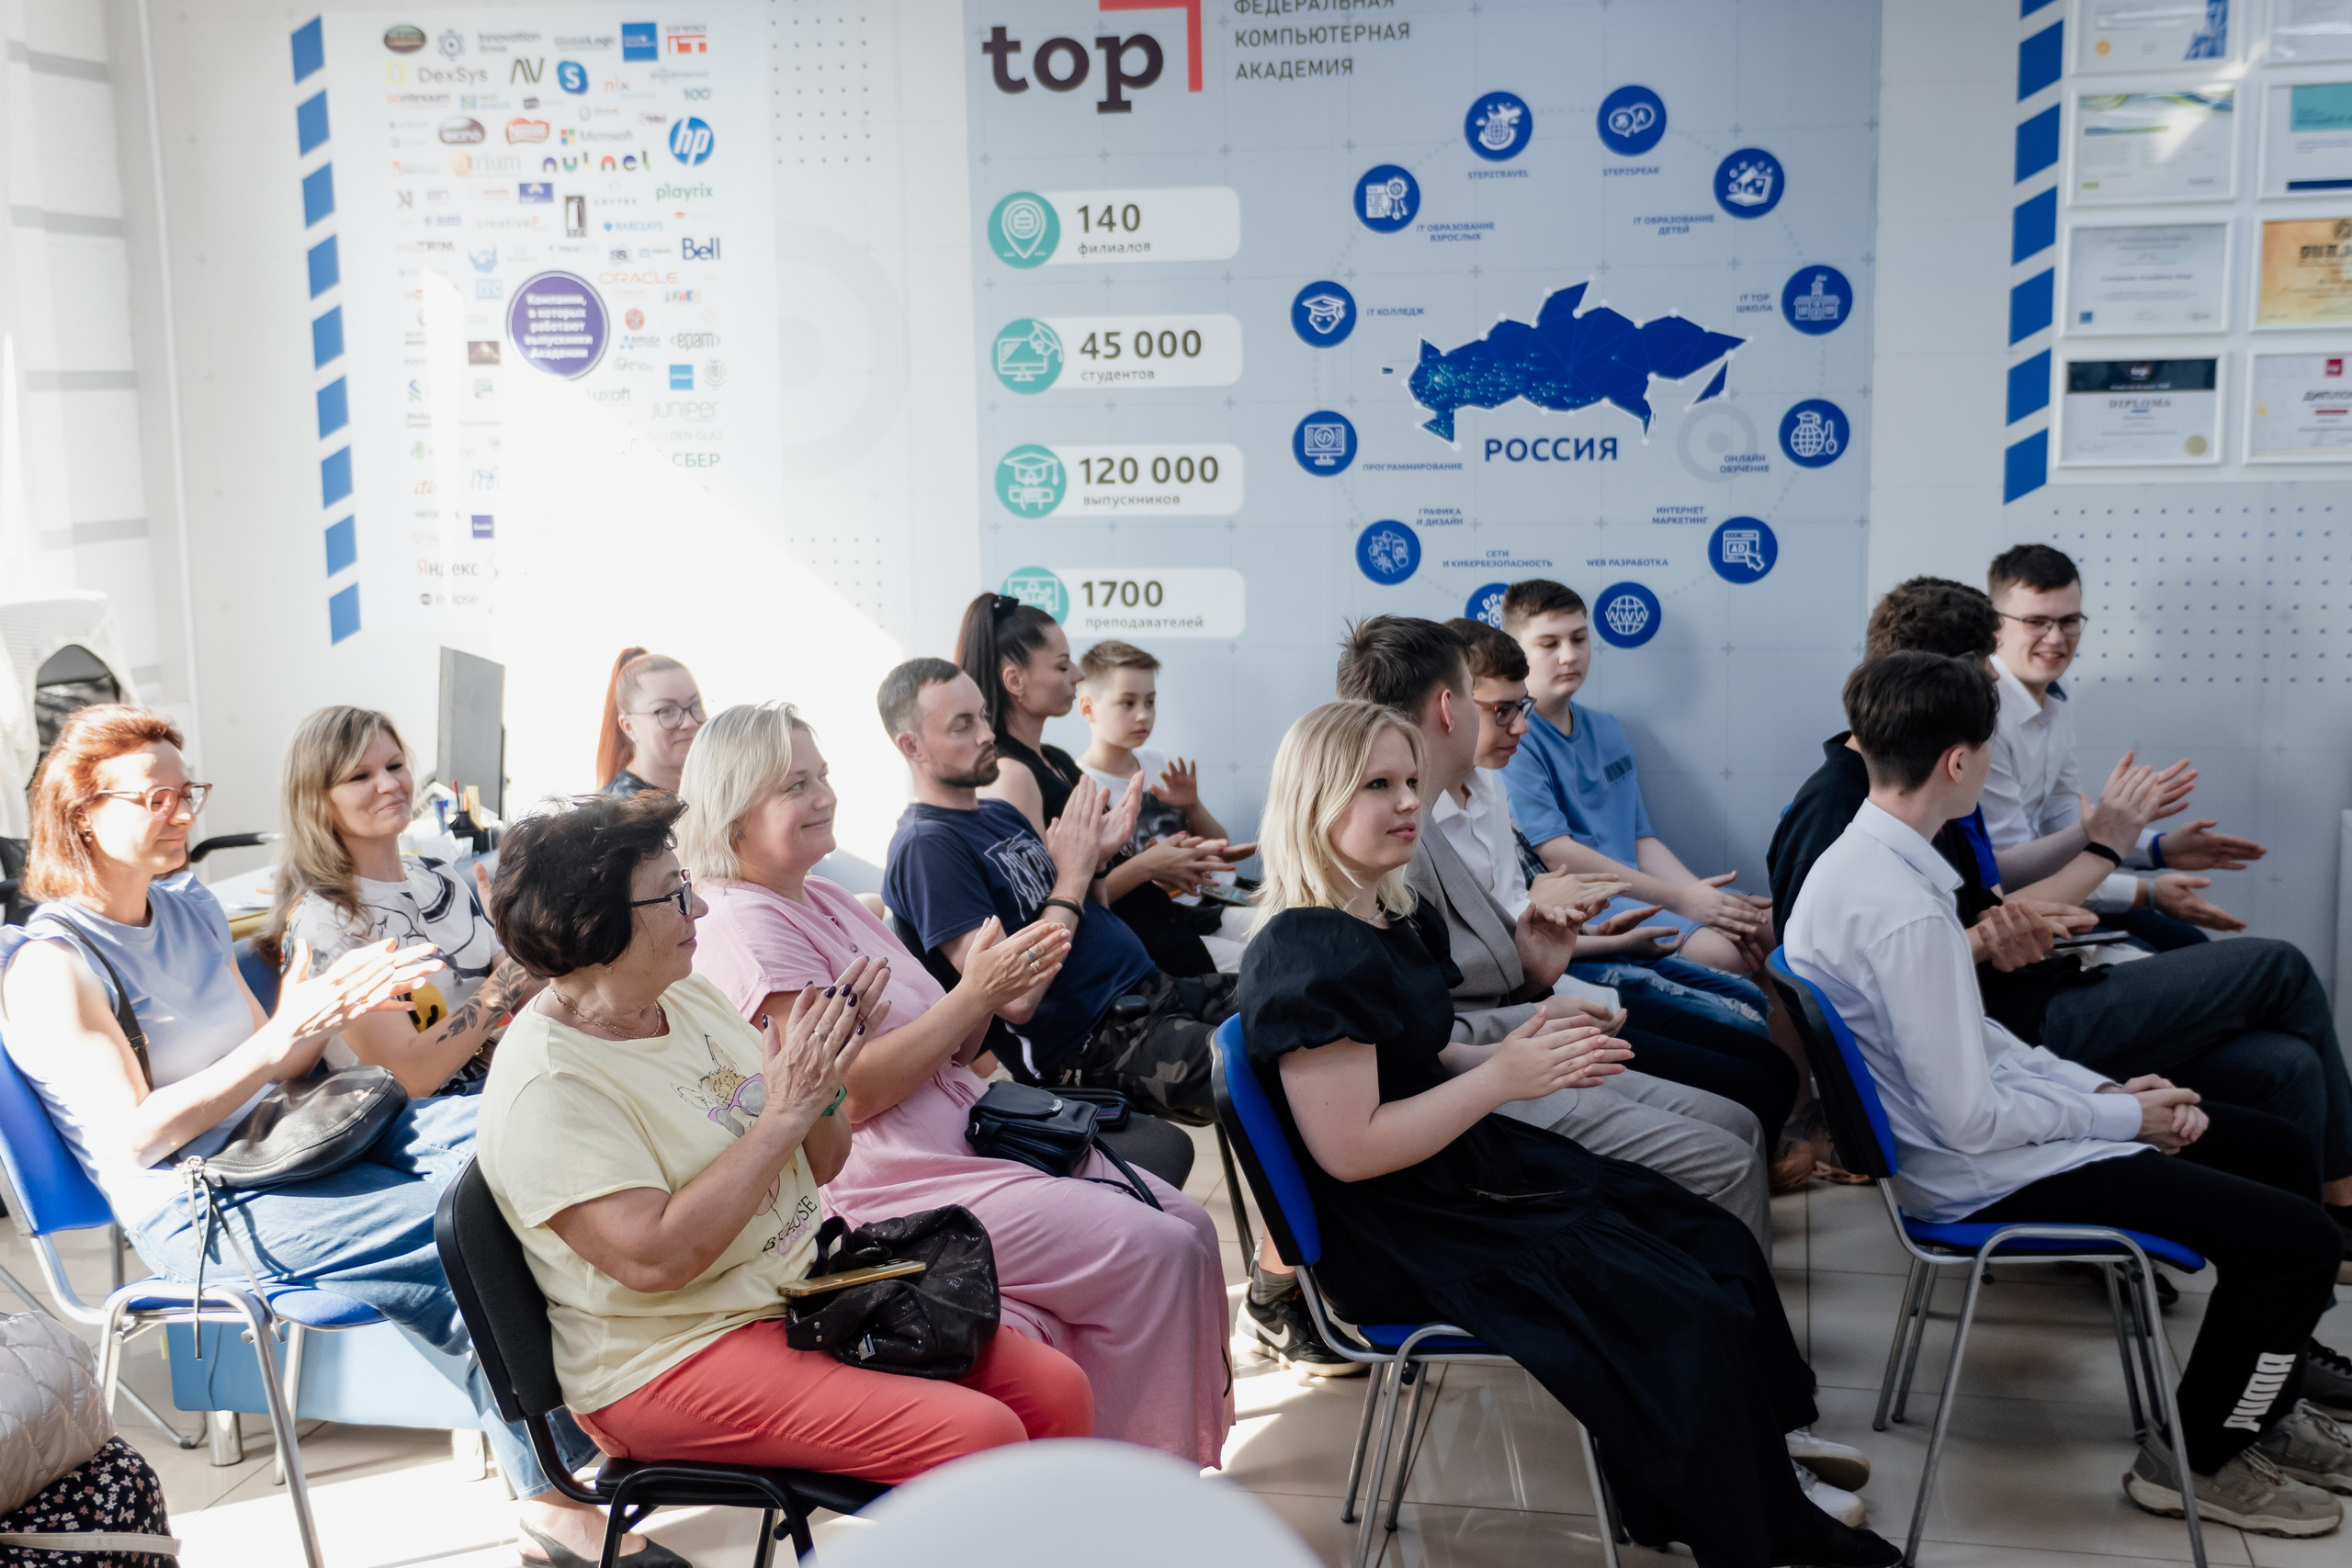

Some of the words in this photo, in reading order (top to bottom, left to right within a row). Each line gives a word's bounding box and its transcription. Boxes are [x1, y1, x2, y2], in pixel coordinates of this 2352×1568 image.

[1235, 23, 1410, 48] КОМПЬЮТЕРНАЯ
[417, 66, 489, 85] DexSys
[982, 26, 1164, 114] top
[1236, 59, 1353, 81] АКАДЕМИЯ
[673, 117, 713, 166] hp
[656, 183, 713, 202] playrix
[1077, 203, 1141, 233] 140
[1645, 215, 1714, 225] ОБРАЗОВАНИЕ
[1427, 222, 1495, 232] ОБРАЗОВАНИЕ
[1657, 225, 1690, 236] ДЕТЕЙ
[1430, 232, 1481, 243] ВЗРОСЛЫХ
[683, 237, 720, 261] Bell
[1078, 242, 1151, 257] филиалов
[599, 272, 679, 285] ORACLE
[1376, 308, 1424, 317] КОЛЛЕДЖ
[1736, 304, 1772, 313] ШКОЛА
[1080, 332, 1122, 360] 45
[1134, 330, 1202, 359] 000
[1081, 369, 1155, 383] студентов
[1485, 437, 1617, 462] РОССИЯ
[673, 453, 720, 468] СБЕР
[1724, 454, 1766, 464] ОНЛАЙН
[1079, 457, 1138, 485] 120
[1151, 457, 1219, 484] 000
[1363, 463, 1463, 471] ПРОГРАММИРОВАНИЕ
[1720, 464, 1770, 473] ОБУЧЕНИЕ
[1083, 494, 1181, 508] выпускников
[1419, 508, 1461, 516] ГРАФИКА
[1657, 506, 1704, 514] ИНТЕРНЕТ
[1425, 516, 1464, 526] ДИЗАЙН
[1652, 516, 1708, 525] МАРКЕТИНГ
[1451, 559, 1553, 568] КИБЕРБЕЗОПАСНОСТЬ
[1609, 558, 1668, 567] РАЗРАБОТКА
[1081, 581, 1163, 608] 1700
[1086, 615, 1204, 631] преподавателей
